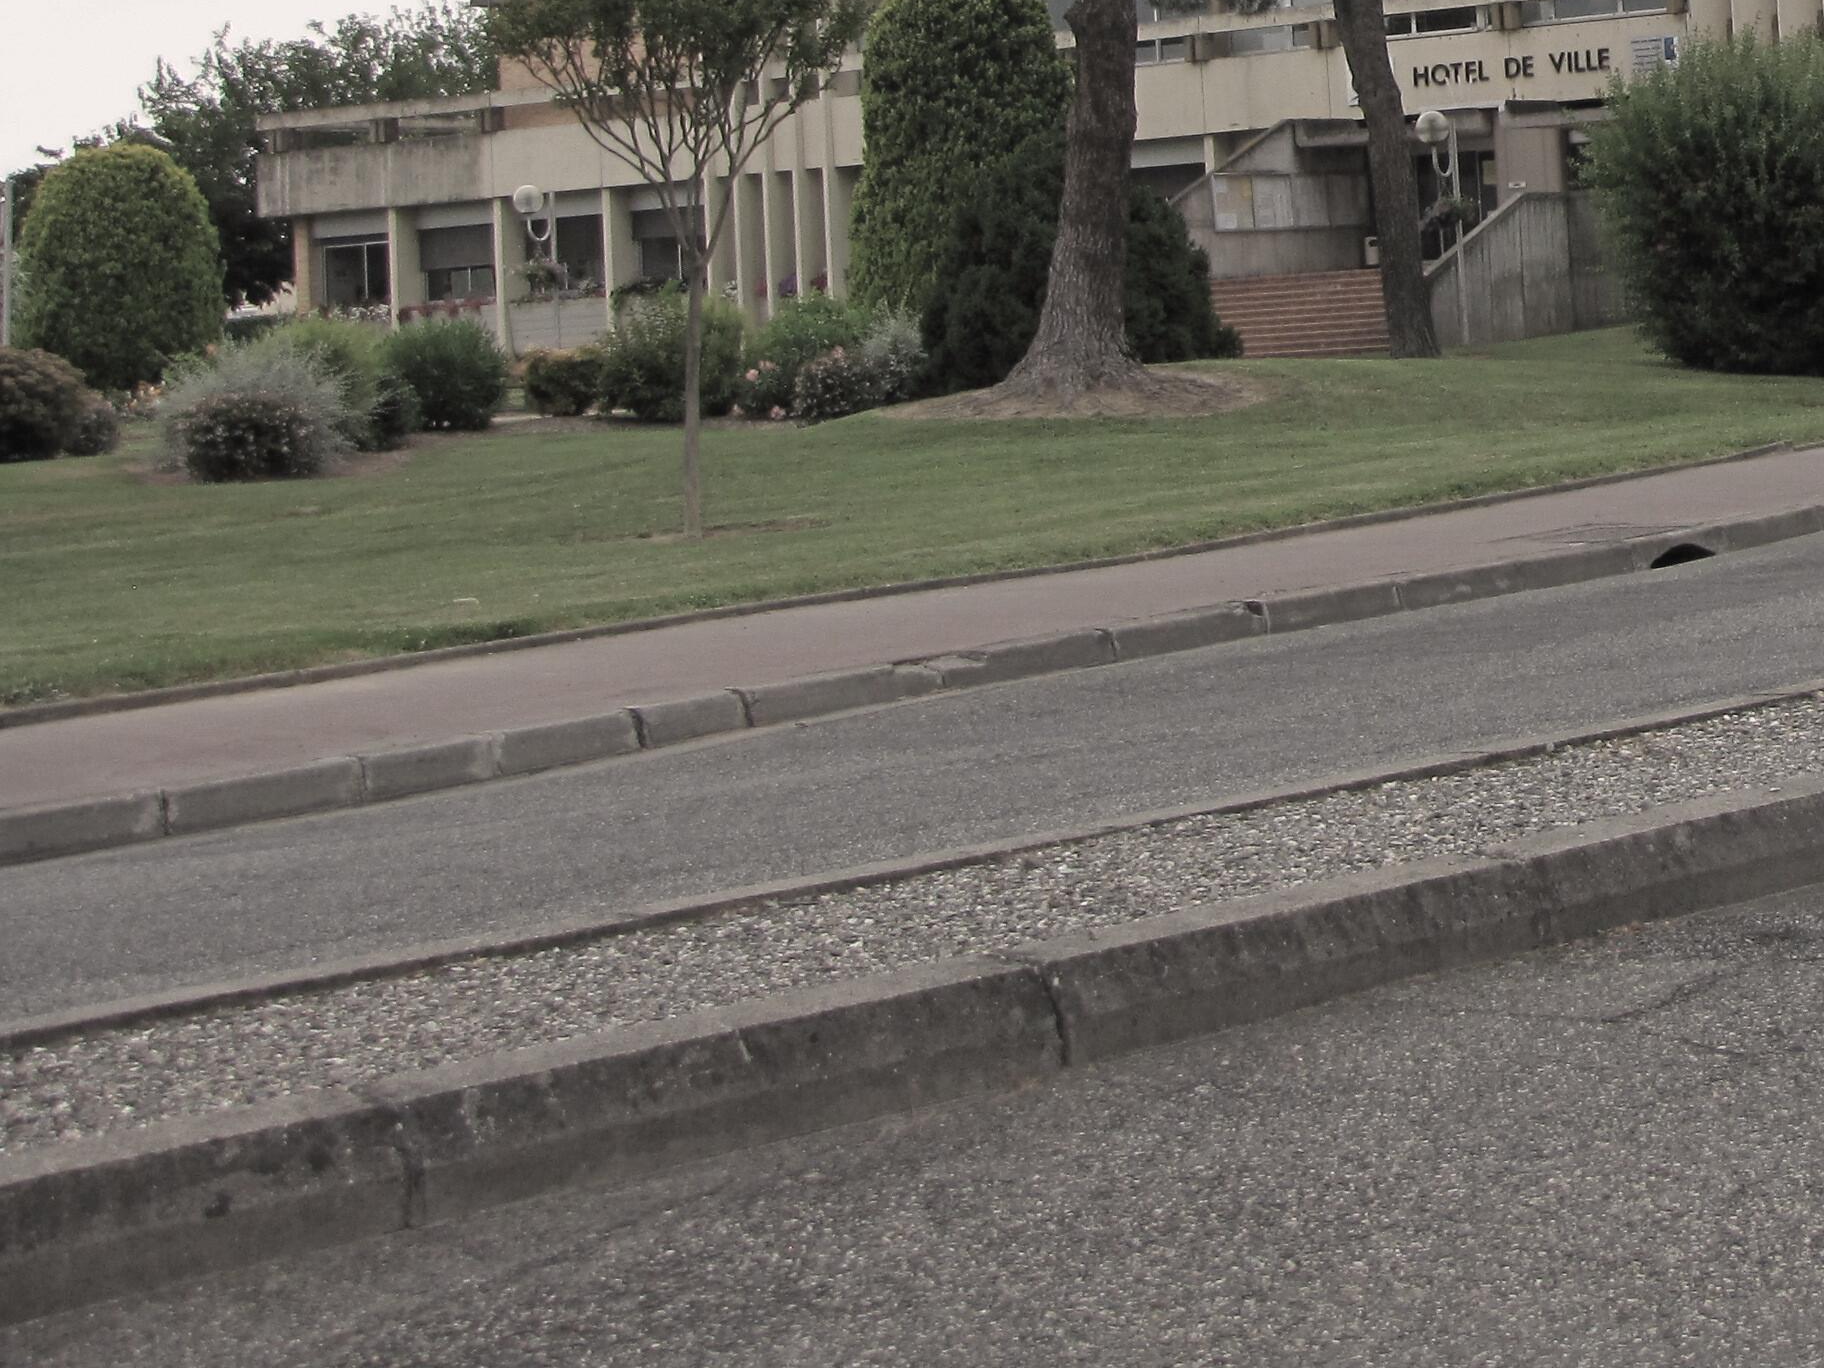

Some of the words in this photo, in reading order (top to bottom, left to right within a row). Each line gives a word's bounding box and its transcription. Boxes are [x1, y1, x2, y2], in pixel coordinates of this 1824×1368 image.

[1412, 60, 1490, 87] HOTEL
[1504, 56, 1535, 79] DE
[1548, 48, 1611, 74] VILLE
